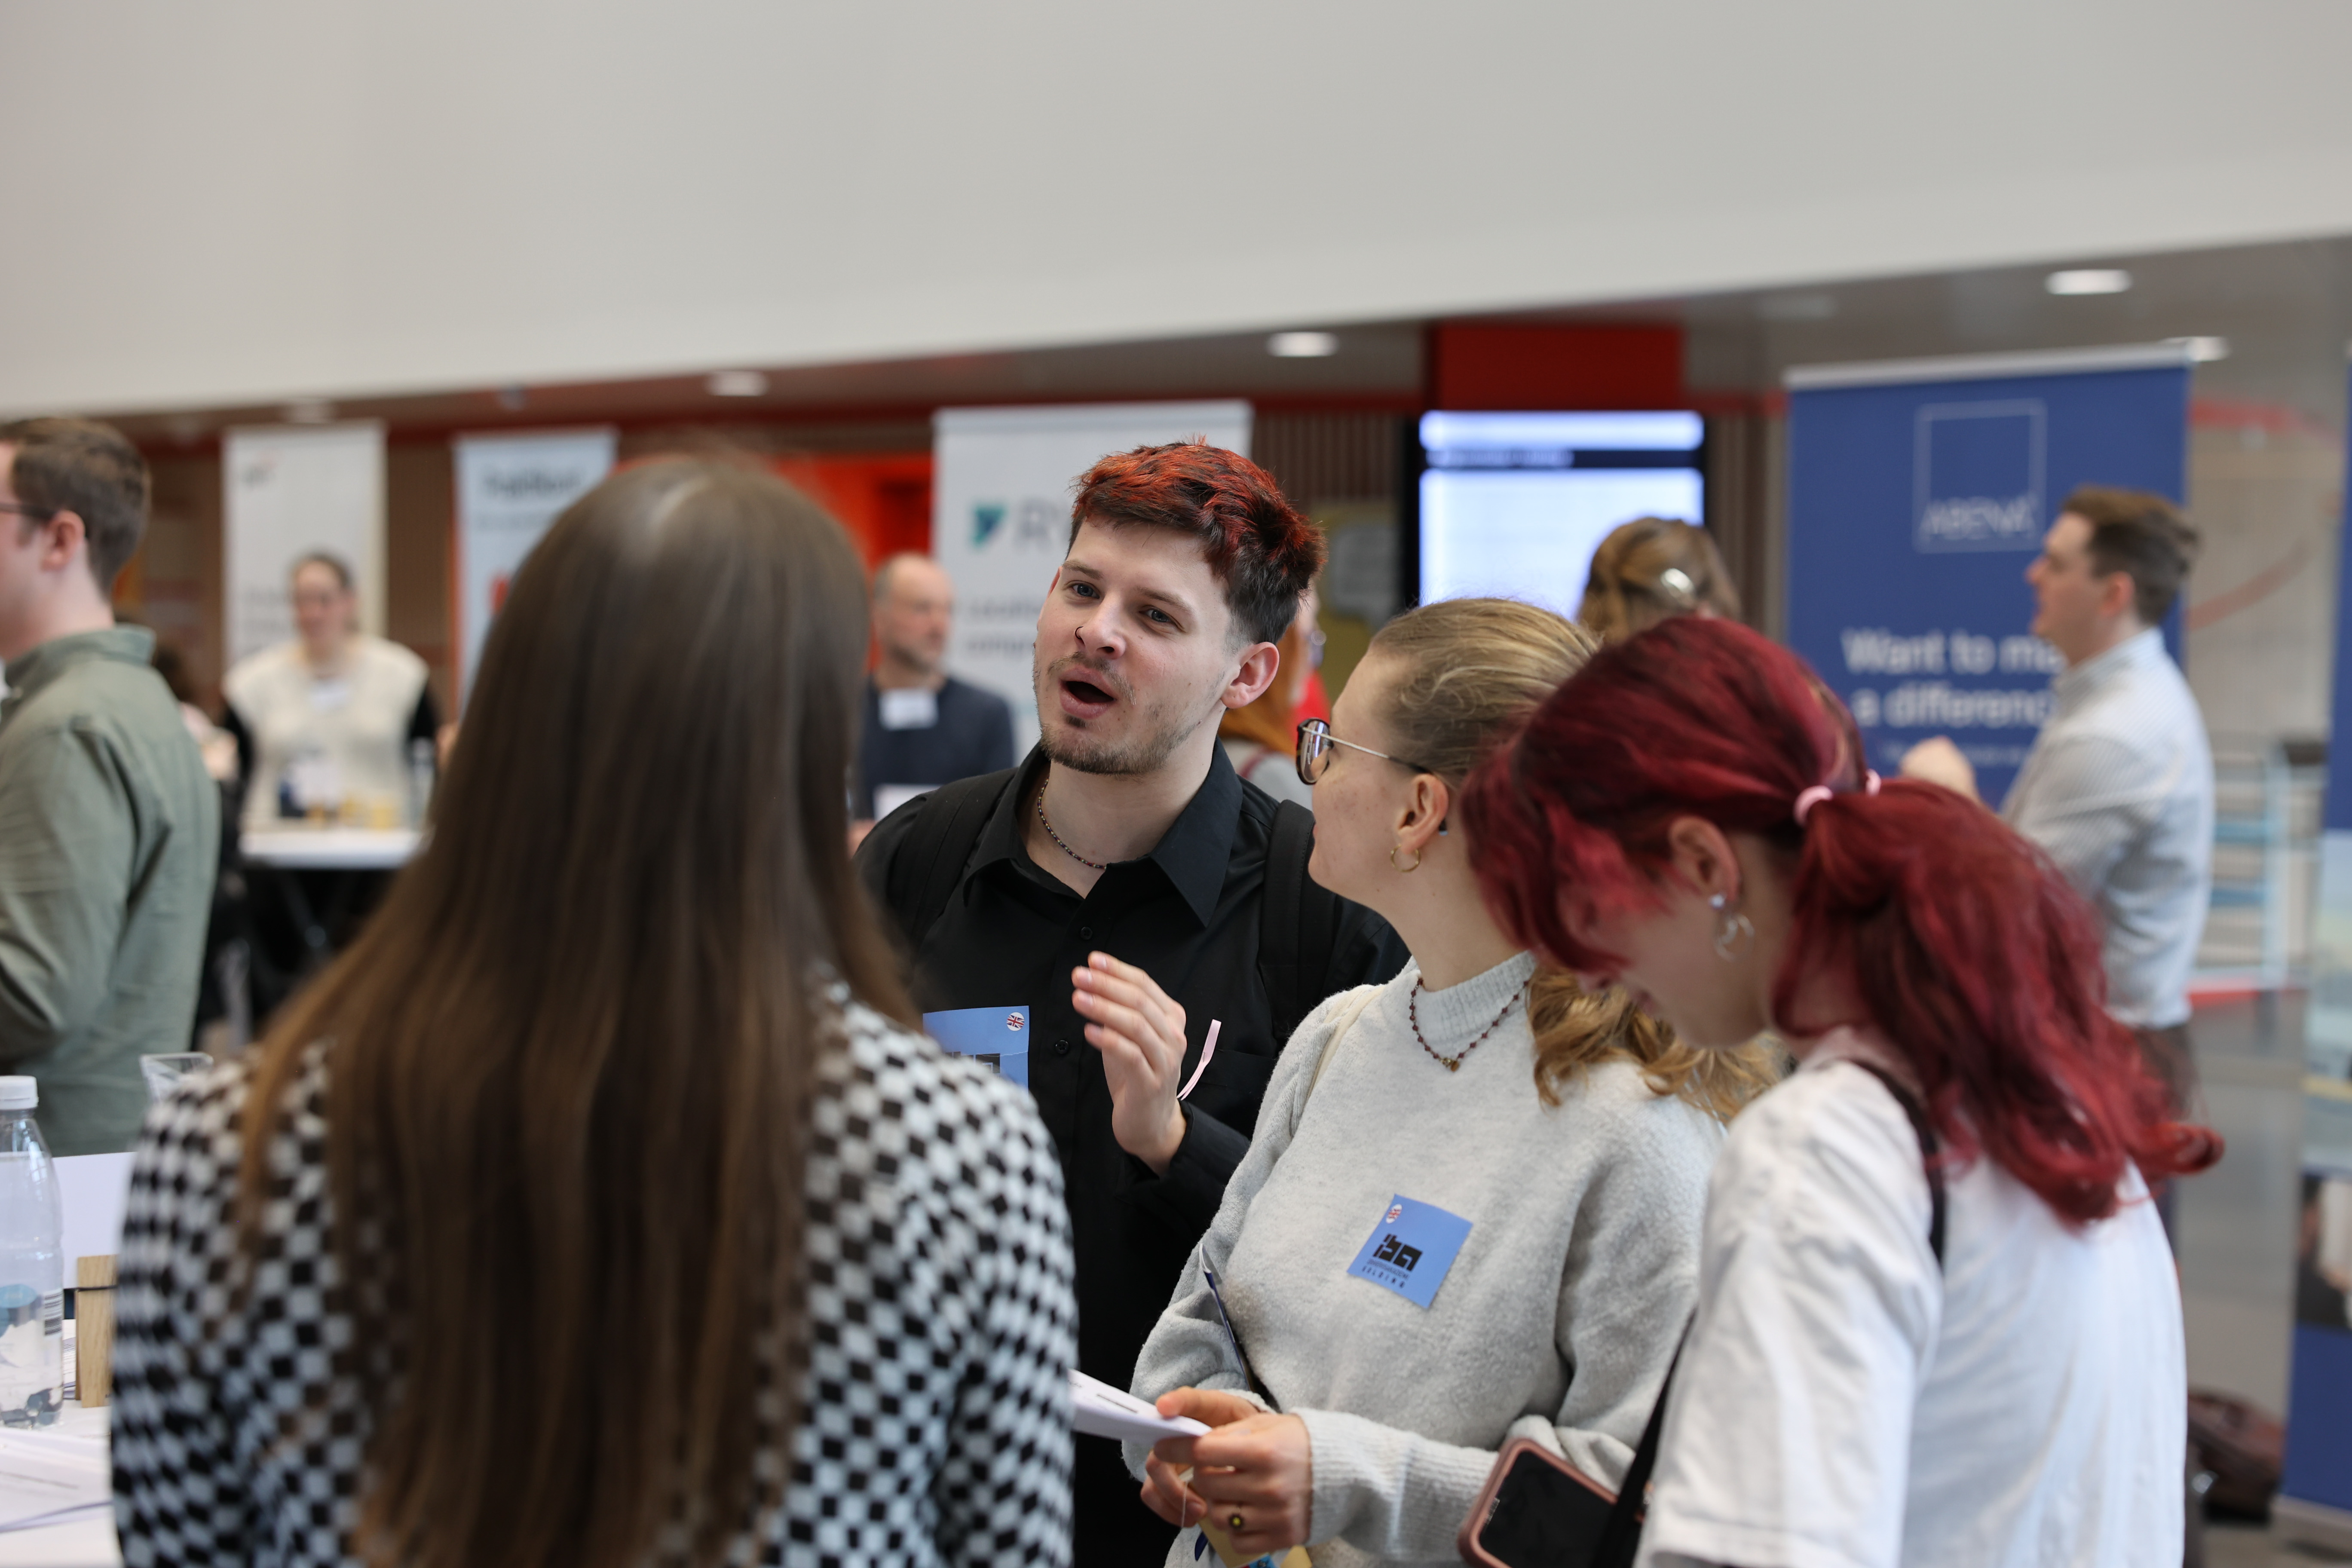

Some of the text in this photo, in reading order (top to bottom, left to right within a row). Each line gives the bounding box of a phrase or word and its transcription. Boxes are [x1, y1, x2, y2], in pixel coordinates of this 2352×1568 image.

[1843, 631, 1945, 671] Want
[1952, 631, 1993, 672] to
[1852, 692, 1877, 725] a
